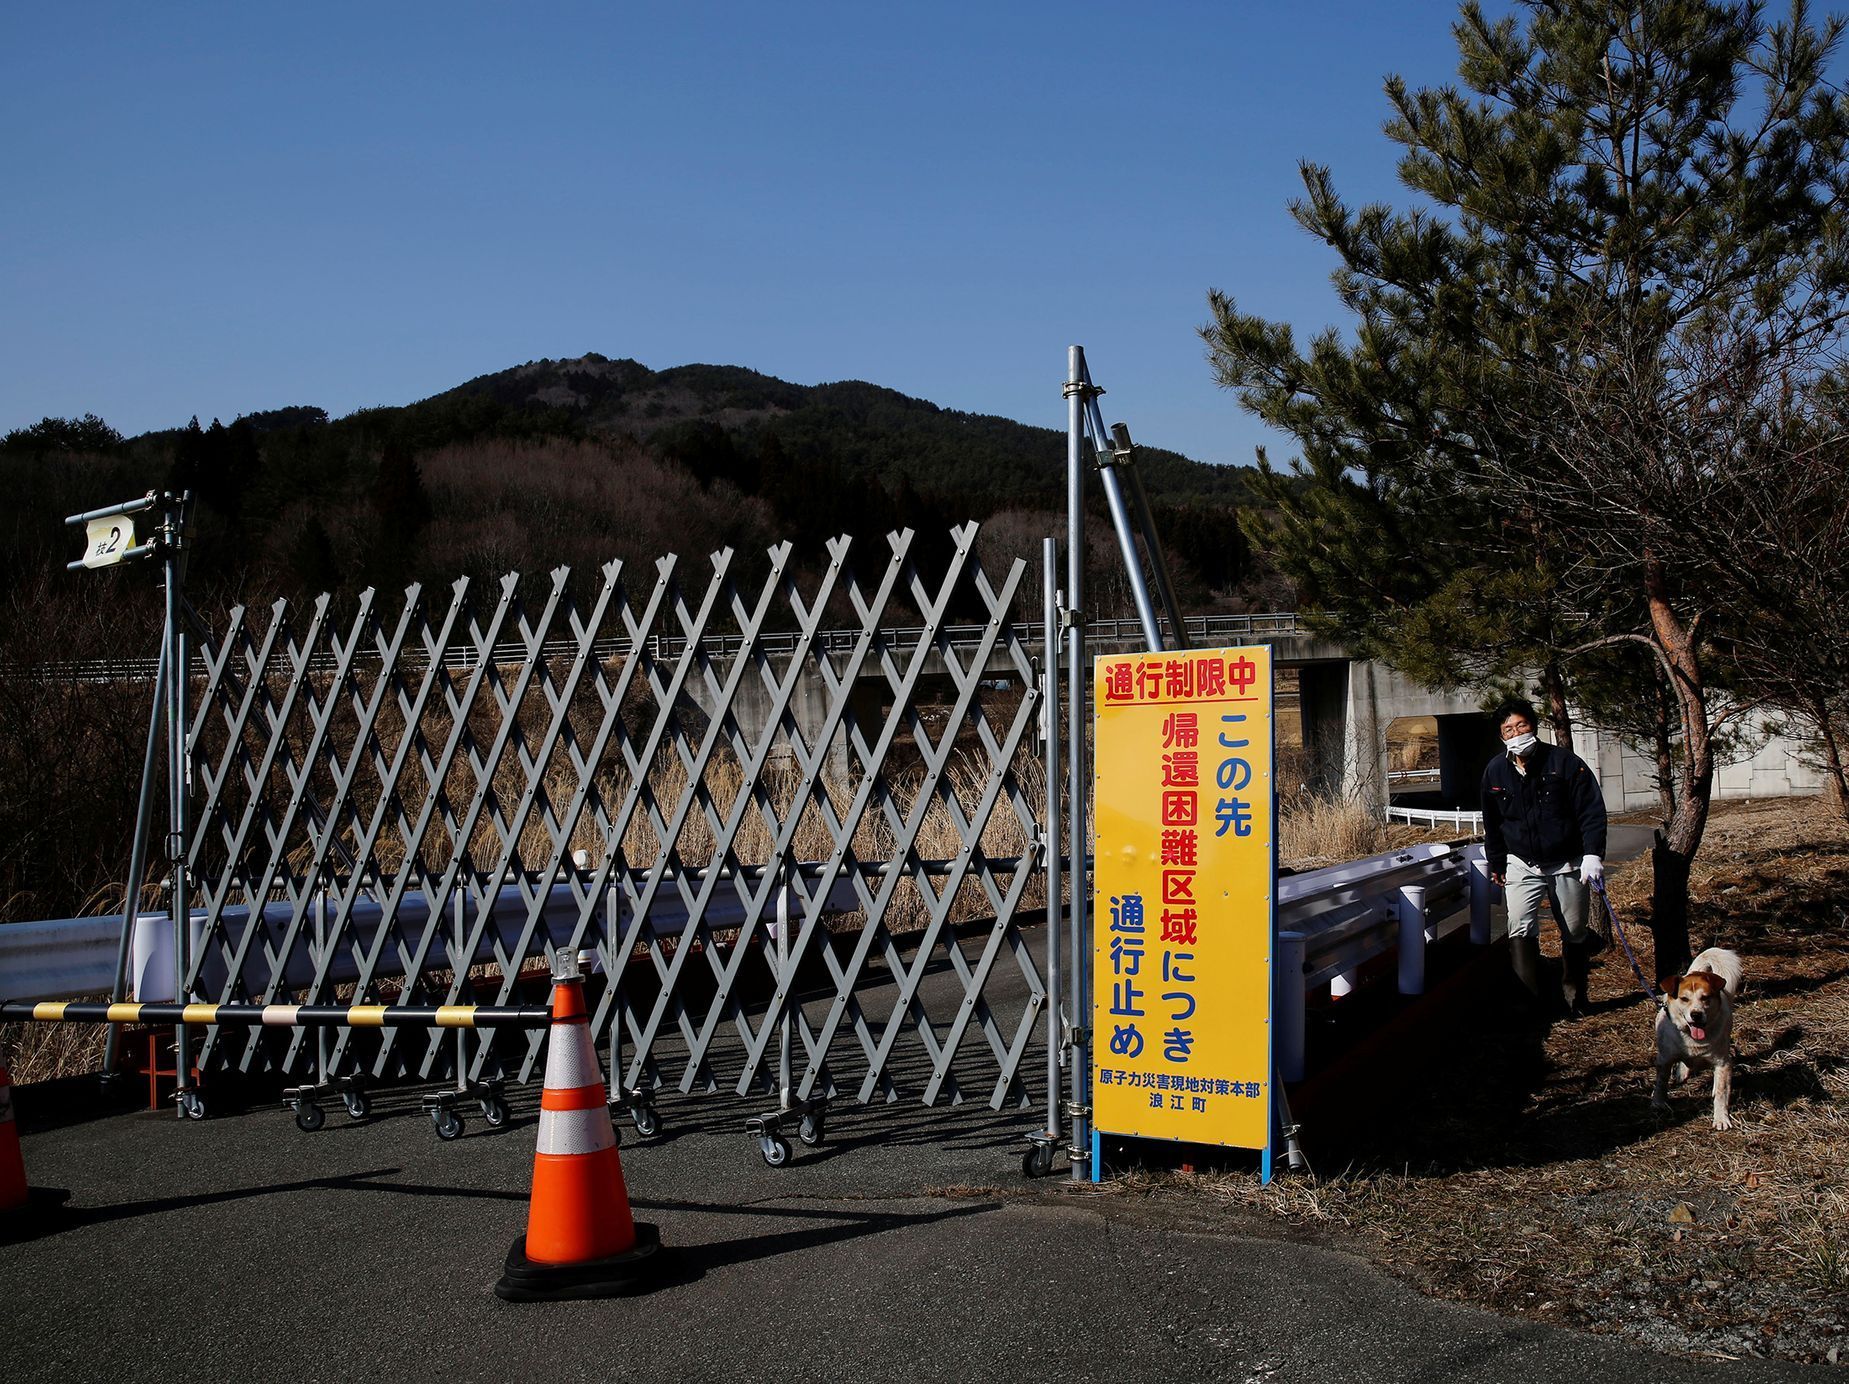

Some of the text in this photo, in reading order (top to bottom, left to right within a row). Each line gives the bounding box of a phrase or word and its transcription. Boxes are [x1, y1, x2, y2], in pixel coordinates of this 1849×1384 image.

[1105, 655, 1255, 700] 通行制限中
[1215, 714, 1251, 837] この先
[1160, 712, 1199, 1062] 帰還困難区域につき
[1109, 894, 1145, 1058] 通行止め
[1100, 1068, 1260, 1098] 原子力災害現地対策本部
[1149, 1092, 1206, 1113] 浪江町
